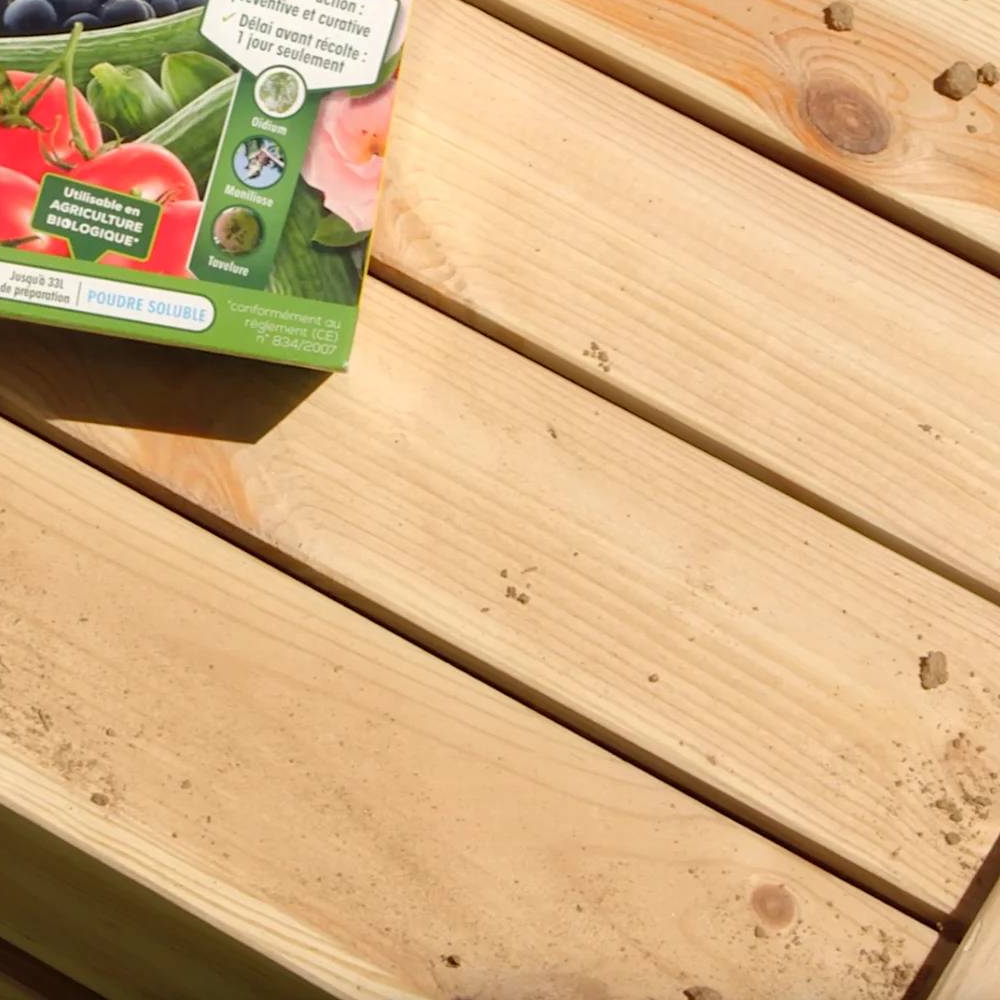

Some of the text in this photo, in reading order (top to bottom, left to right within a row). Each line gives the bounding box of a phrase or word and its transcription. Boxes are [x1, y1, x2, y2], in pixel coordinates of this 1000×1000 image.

[302, 9, 315, 22] et
[318, 11, 371, 38] curative
[238, 14, 274, 36] Délai
[275, 25, 314, 47] avant
[315, 36, 360, 61] récolte
[237, 31, 345, 74] 1 jour seulement
[63, 186, 140, 217] Utilisable en
[49, 199, 144, 233] AGRICULTURE
[208, 256, 250, 277] Tavelure
[0, 282, 71, 304] de préparation
[47, 277, 64, 290] 33L
[87, 288, 207, 322] POUDRE SOLUBLE
[312, 328, 339, 344] (CE)
[324, 319, 341, 330] au
[271, 335, 337, 355] 834/2007
